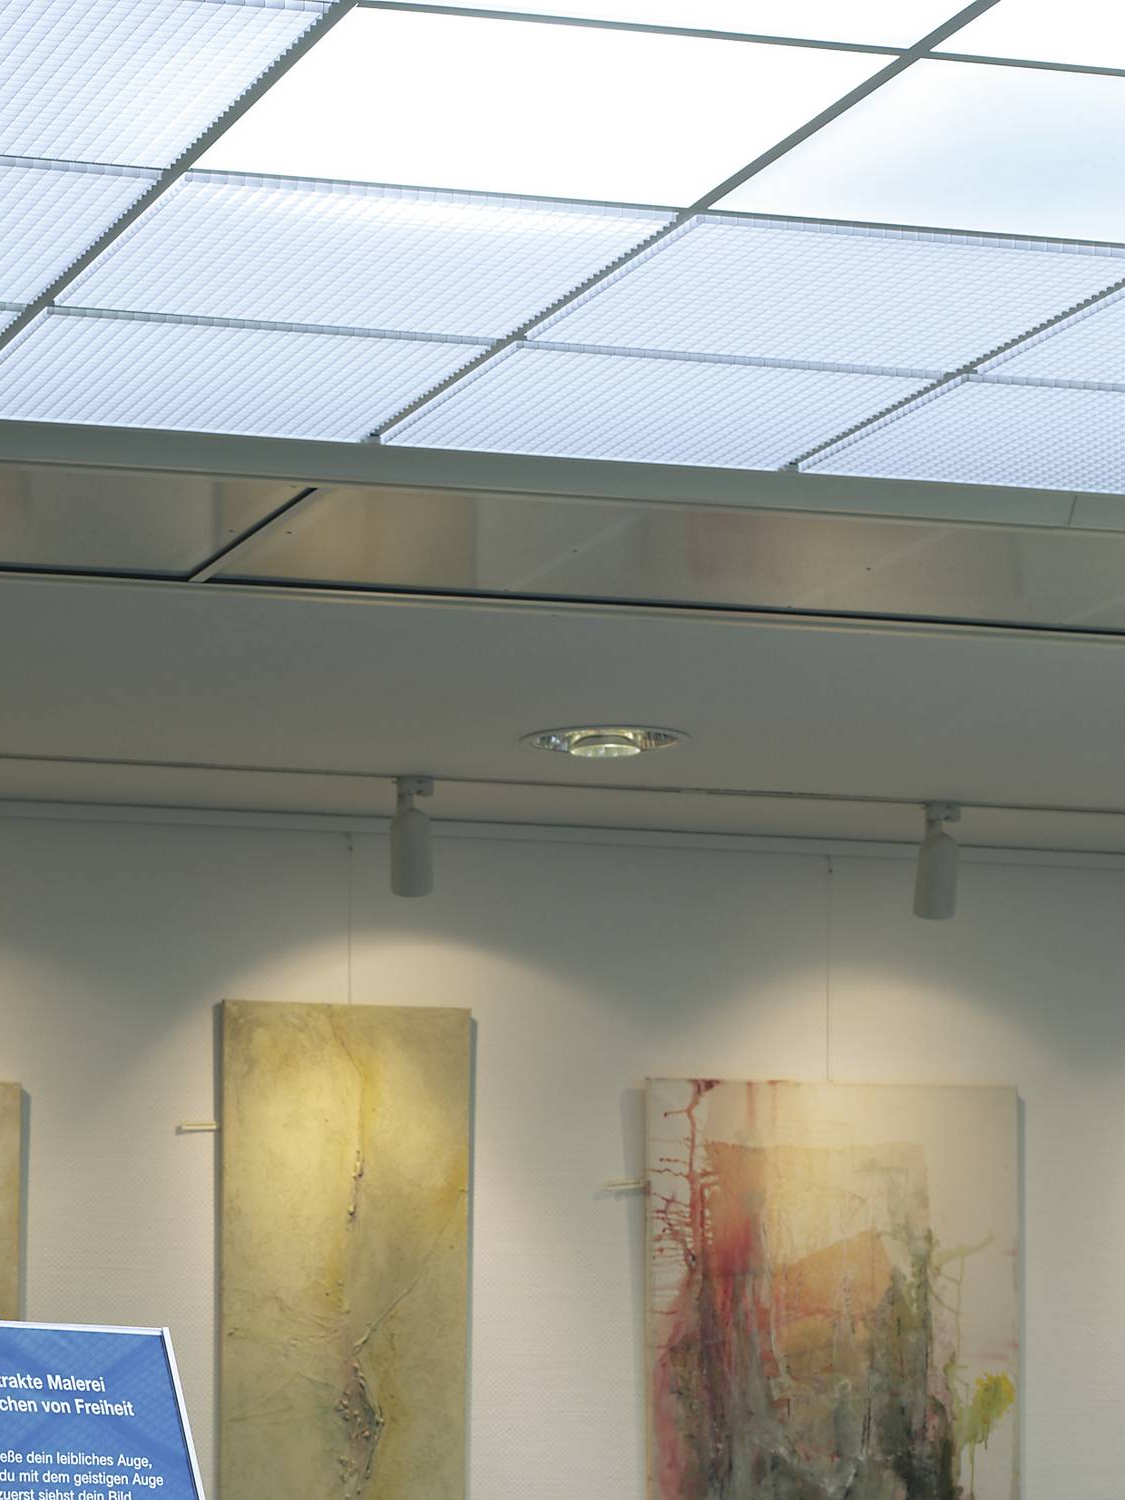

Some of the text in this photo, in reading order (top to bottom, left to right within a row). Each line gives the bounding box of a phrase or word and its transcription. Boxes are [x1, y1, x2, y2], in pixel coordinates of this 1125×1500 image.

[47, 1375, 105, 1392] Malerei
[40, 1400, 71, 1414] von
[74, 1399, 134, 1416] Freiheit
[26, 1451, 53, 1464] dein
[57, 1451, 113, 1466] leibliches
[117, 1454, 153, 1469] Auge,
[0, 1468, 15, 1482] du
[19, 1469, 39, 1483] mit
[43, 1470, 69, 1484] dem
[73, 1471, 128, 1487] geistigen
[131, 1473, 163, 1488] Auge
